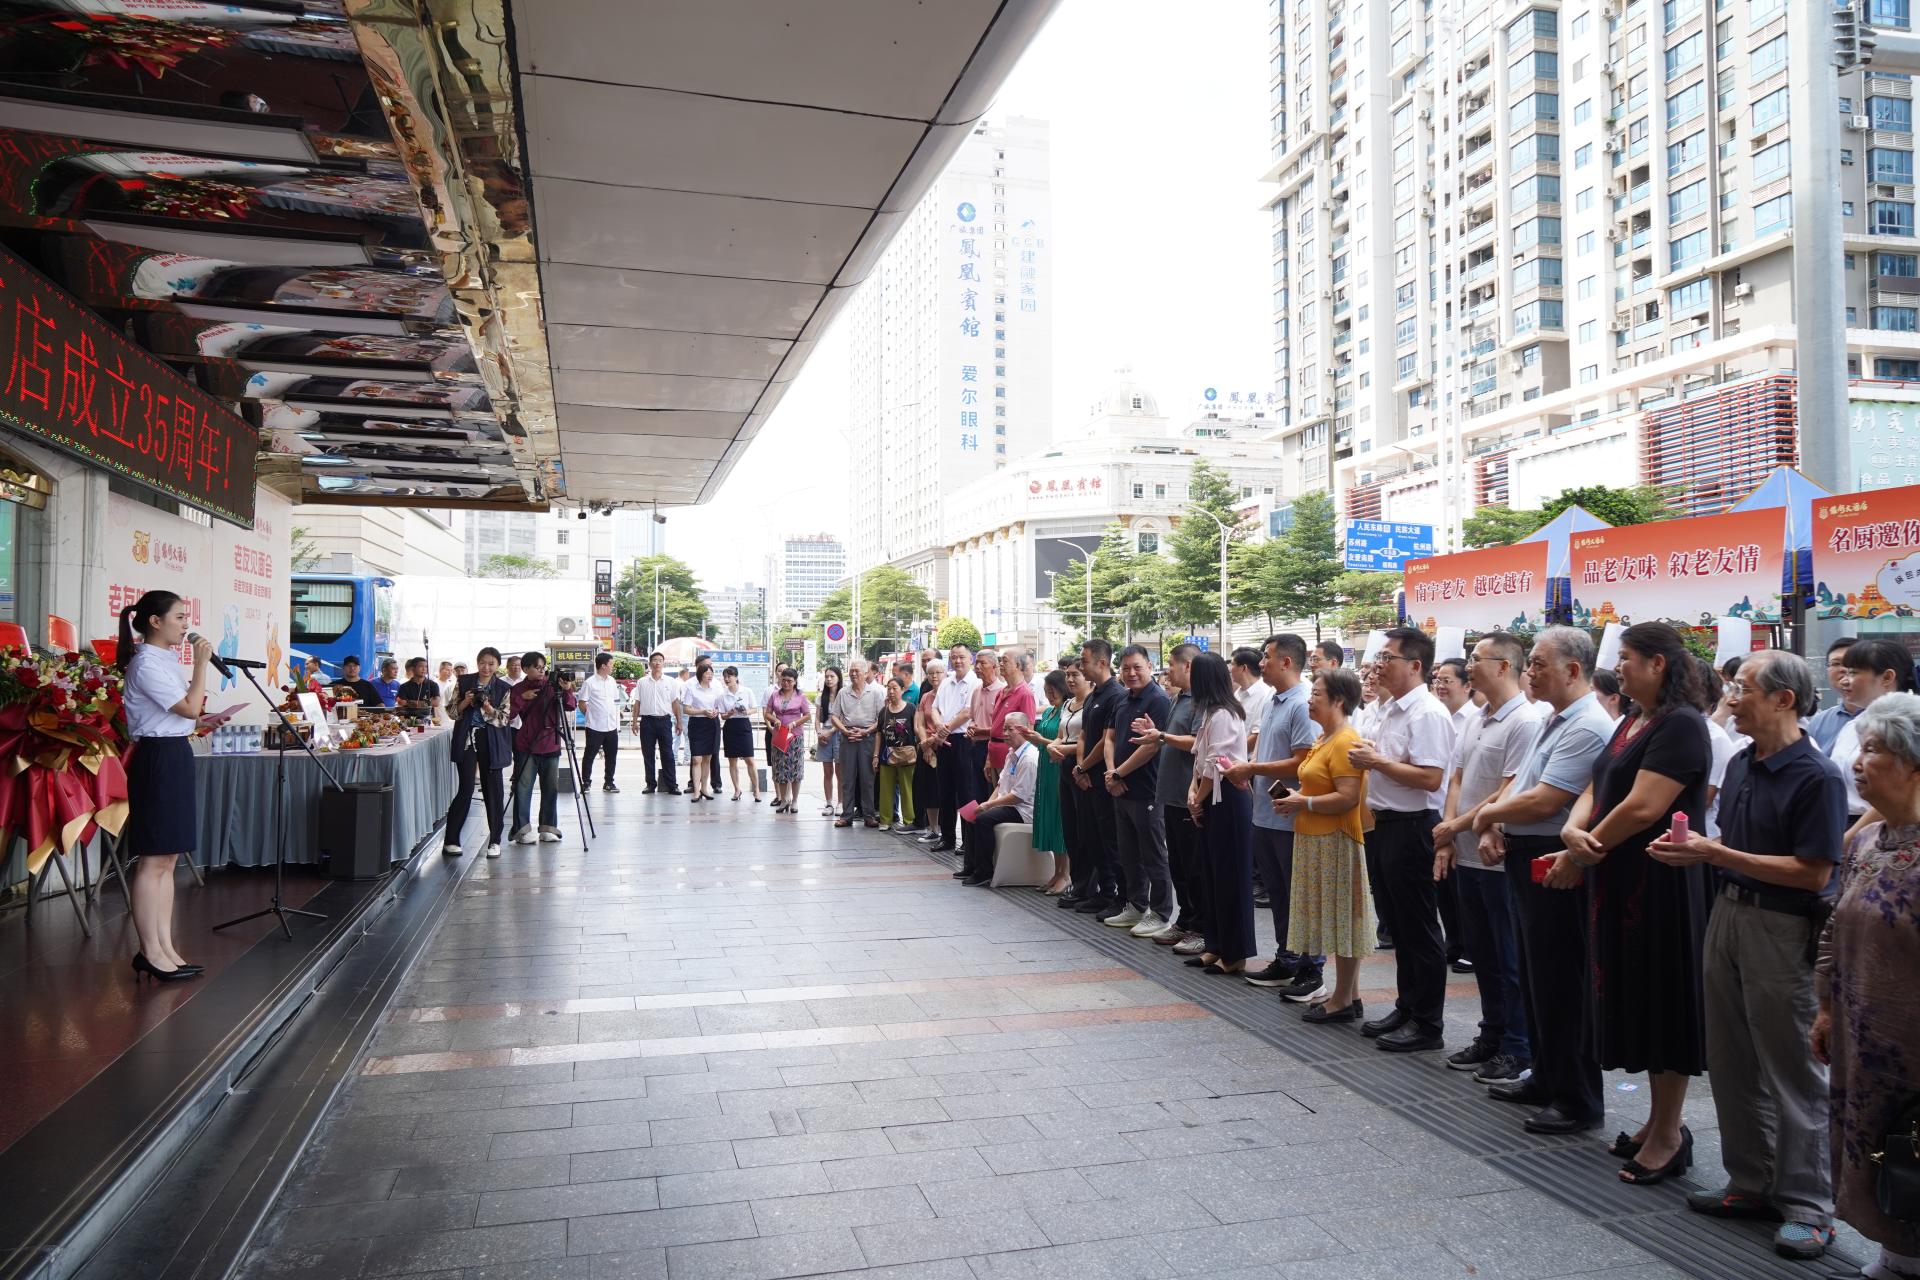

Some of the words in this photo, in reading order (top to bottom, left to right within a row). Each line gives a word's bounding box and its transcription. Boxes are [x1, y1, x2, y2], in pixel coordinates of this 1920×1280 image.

[0, 276, 231, 494] 店成立35周年!
[961, 365, 979, 452] 爱尔眼科
[1829, 519, 1920, 553] 名厨邀你
[234, 544, 272, 579] 老友见面会
[1583, 555, 1658, 585] 品老友味
[1668, 544, 1761, 578] 叙老友情
[1415, 579, 1467, 604] 南宁老友
[1474, 570, 1533, 597] 越吃越有
[558, 651, 591, 661] 机场巴士
[722, 652, 767, 662] 机场巴士
